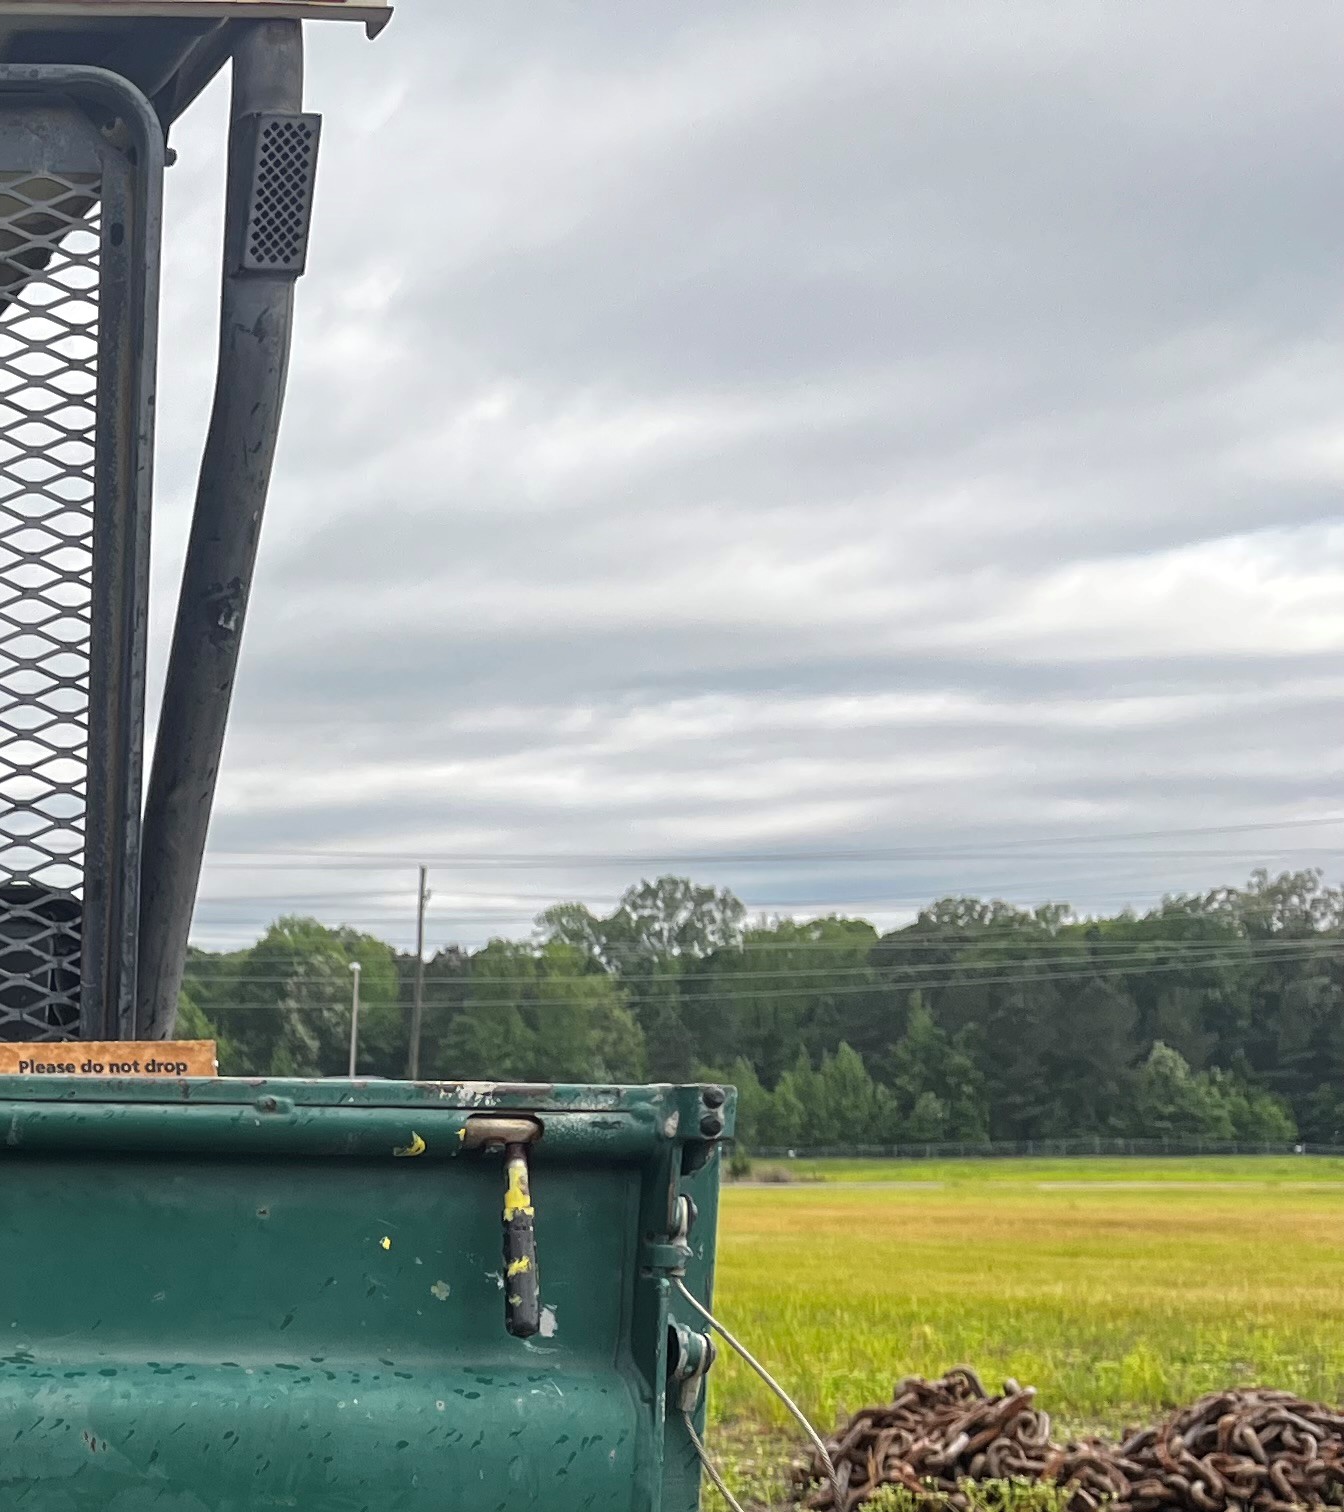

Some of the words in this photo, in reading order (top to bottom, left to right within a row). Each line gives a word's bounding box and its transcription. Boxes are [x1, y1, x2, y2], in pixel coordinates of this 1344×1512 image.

[18, 1060, 76, 1074] Please
[80, 1059, 105, 1074] do
[108, 1060, 141, 1074] not
[144, 1058, 188, 1076] drop
